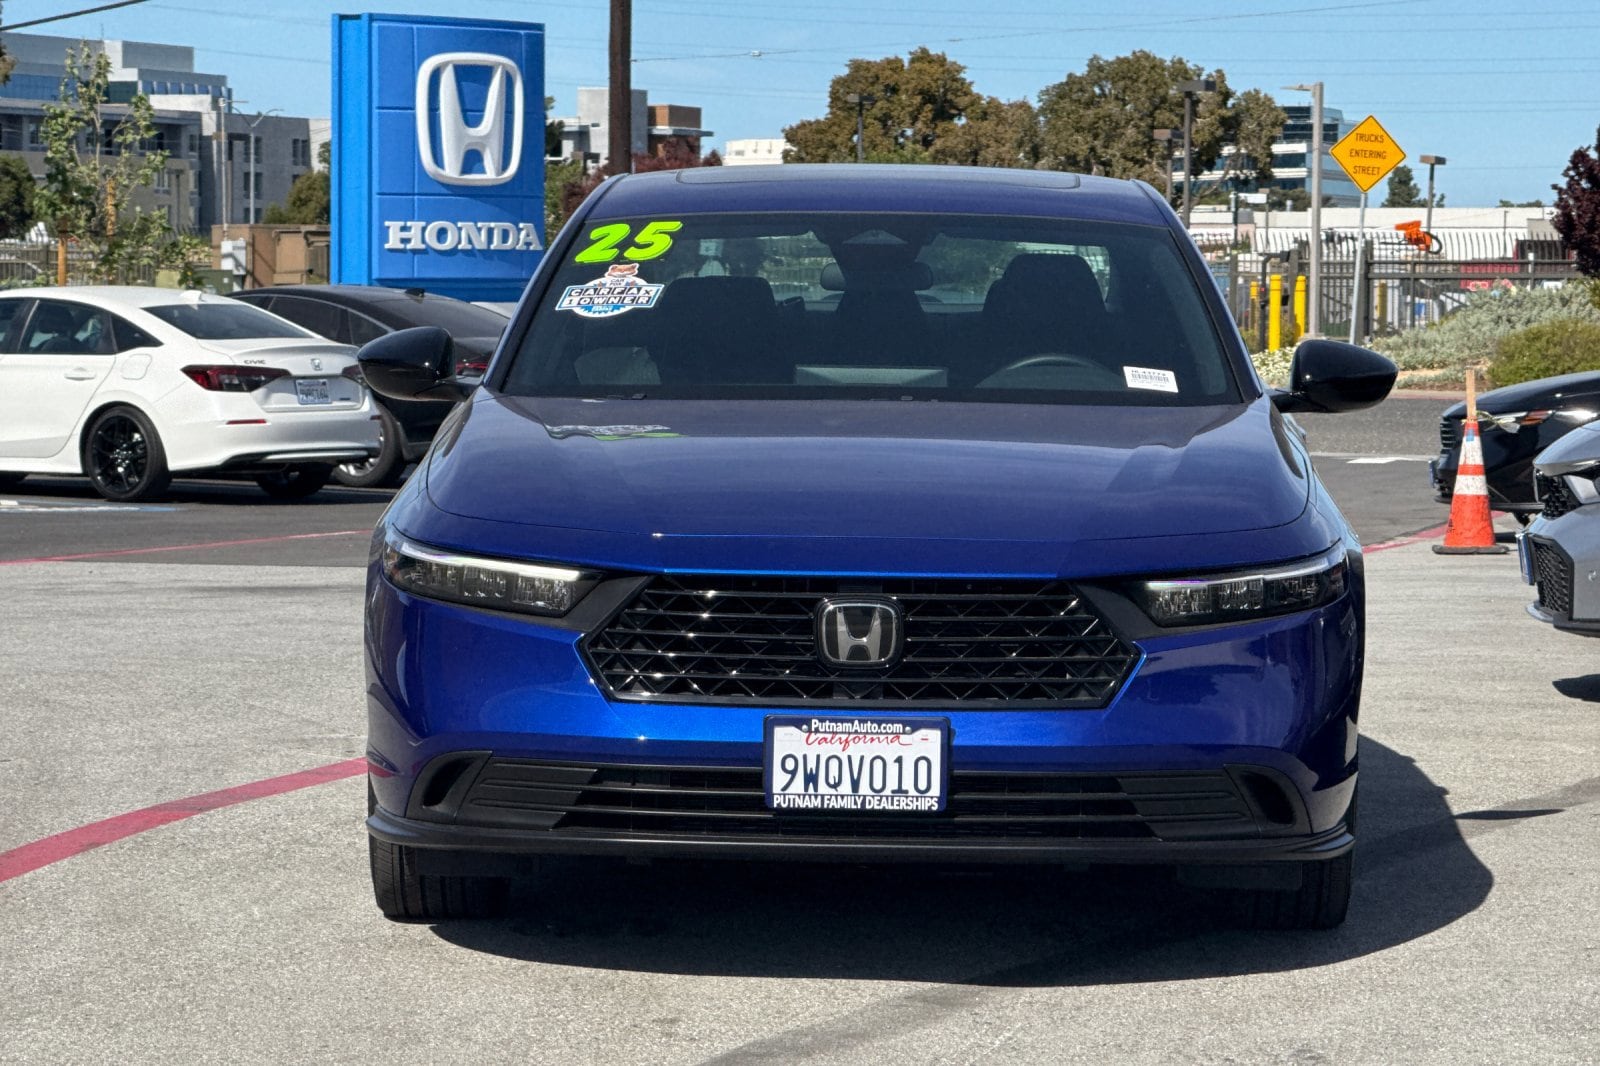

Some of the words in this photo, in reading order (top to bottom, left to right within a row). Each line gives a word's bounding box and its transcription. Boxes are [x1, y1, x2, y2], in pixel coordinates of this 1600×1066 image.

[1355, 133, 1385, 143] TRUCKS
[1349, 148, 1387, 160] ENTERING
[1352, 165, 1381, 176] STREET
[384, 221, 543, 250] HONDA
[575, 221, 682, 263] 25
[569, 286, 654, 297] CARFAX
[580, 296, 650, 305] OWNER
[811, 719, 903, 734] PutnamAuto.com
[805, 731, 912, 752] California
[780, 753, 932, 795] 9WQV010
[773, 794, 821, 808] PUTNAM
[823, 796, 863, 809] FAMILY
[865, 797, 939, 811] DEALERSHIPS
